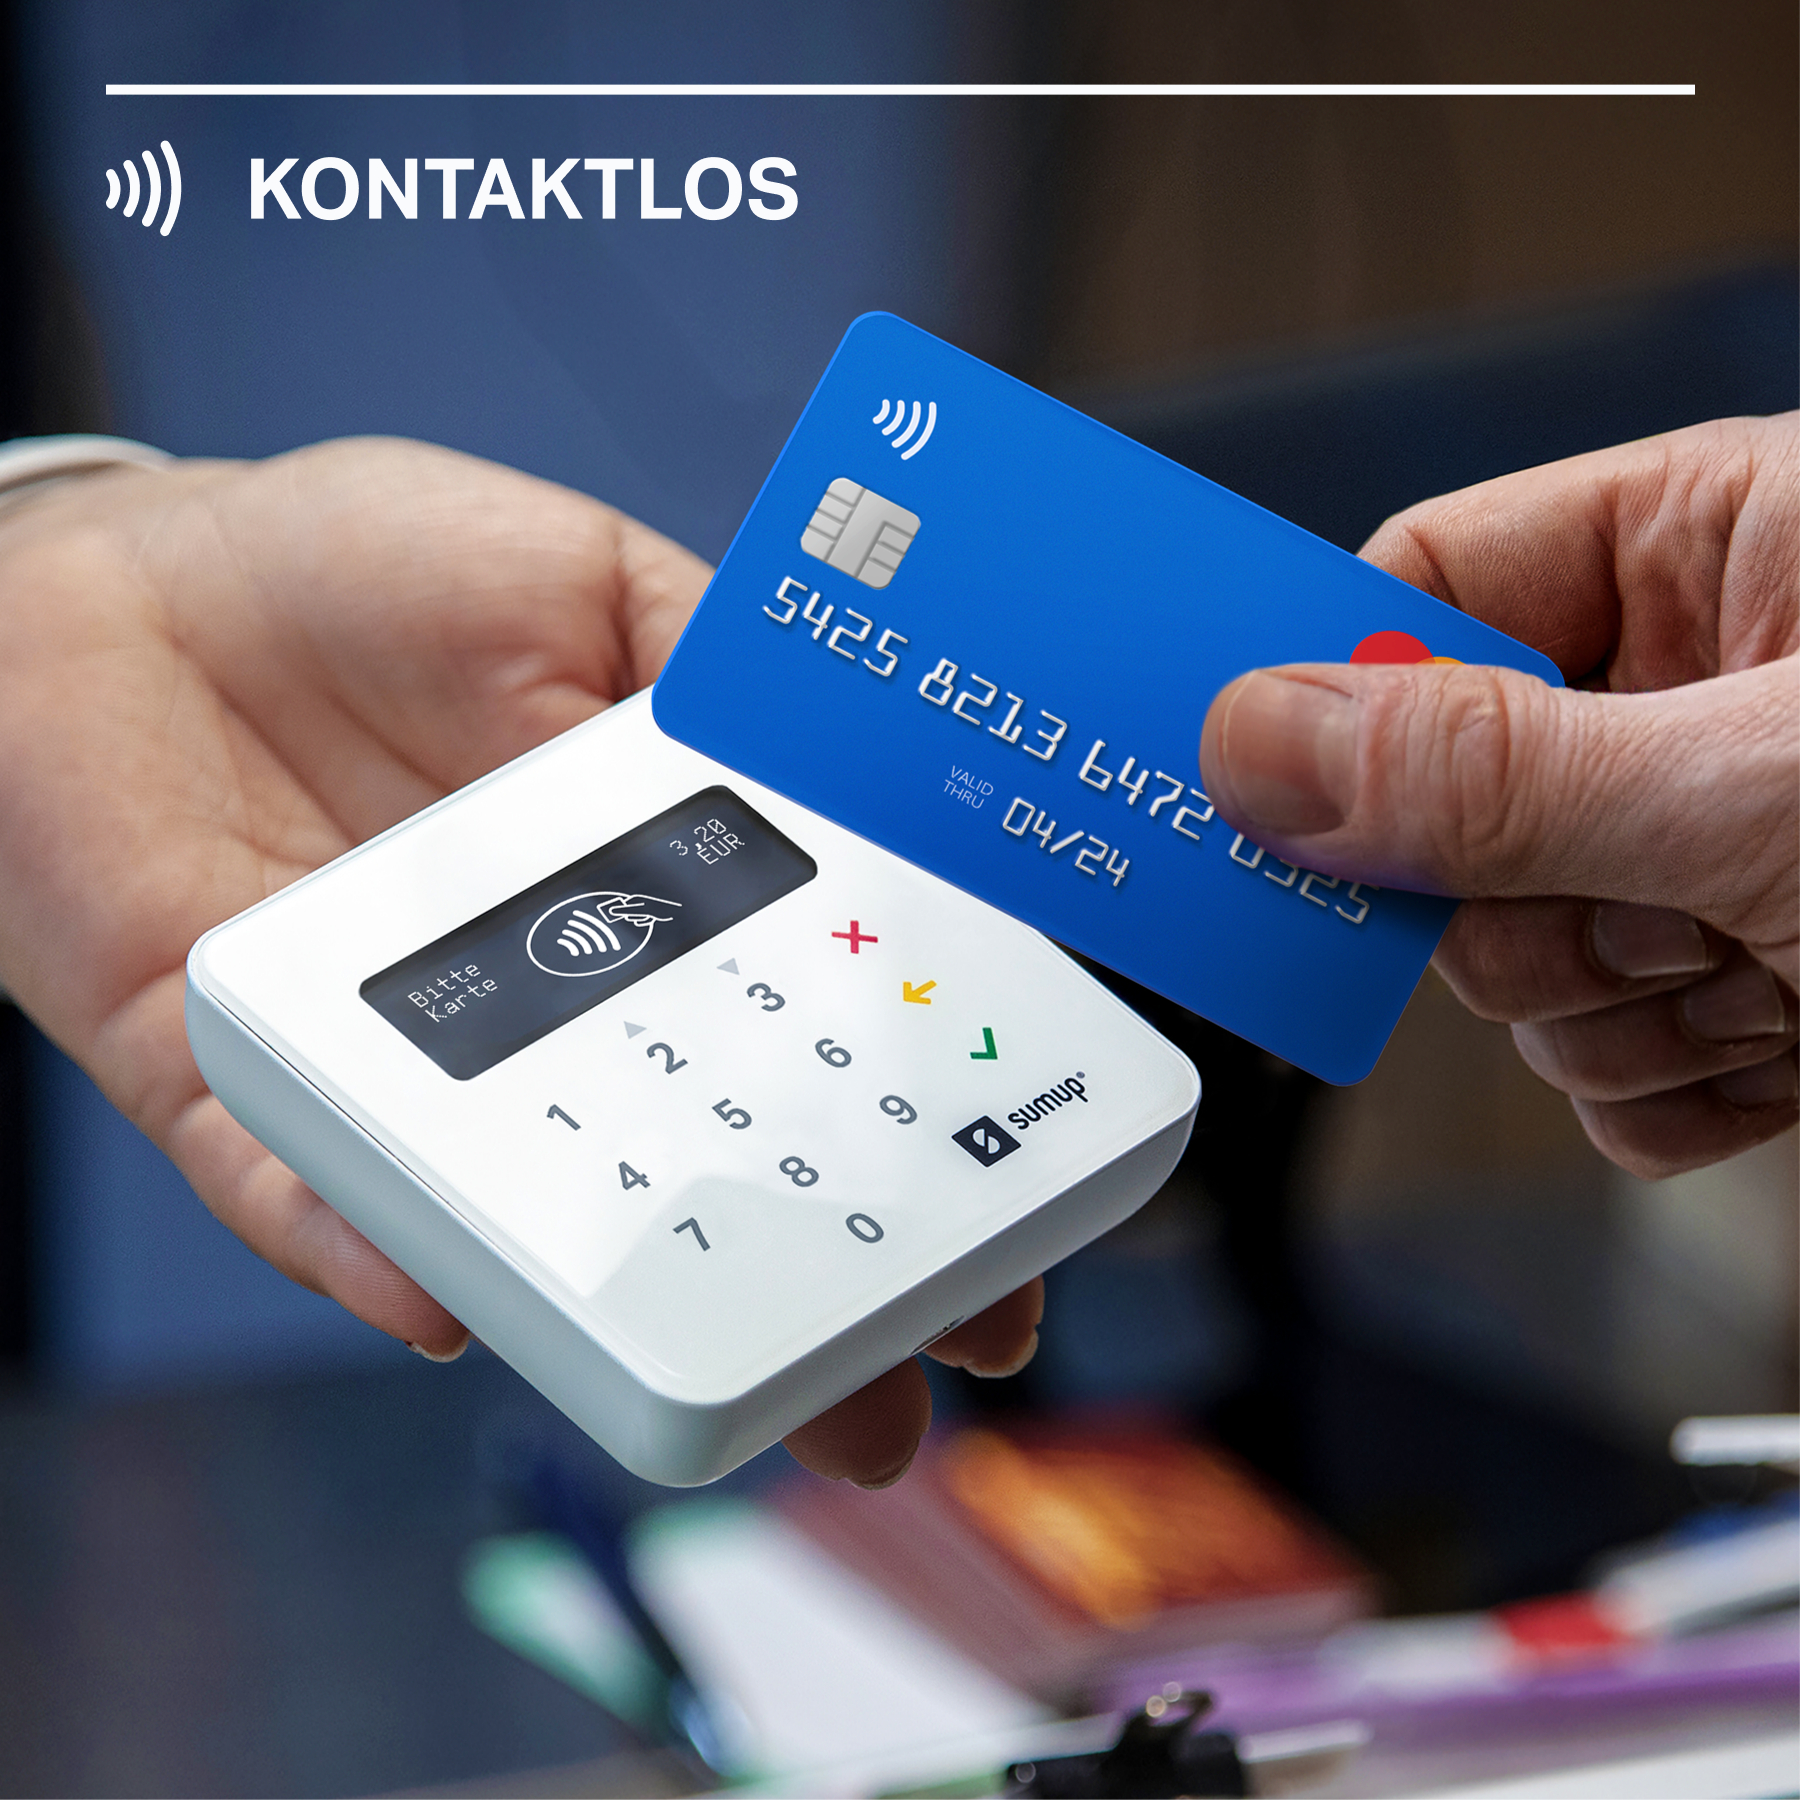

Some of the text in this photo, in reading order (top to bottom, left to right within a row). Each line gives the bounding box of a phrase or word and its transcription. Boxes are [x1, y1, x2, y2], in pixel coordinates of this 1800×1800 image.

[762, 576, 909, 677] 5425
[918, 657, 1068, 761] 8213
[1078, 738, 1216, 841] 6472
[943, 779, 985, 809] THRU
[951, 765, 994, 796] VALID
[696, 833, 745, 865] EUR
[1001, 796, 1131, 887] 04/24
[407, 964, 481, 1008] Bitte
[424, 979, 498, 1023] Karte
[546, 982, 786, 1131] 1 2 3
[618, 1038, 852, 1191] 4 5 6
[672, 1094, 918, 1252] 7 8 9
[845, 1212, 885, 1244] 0
